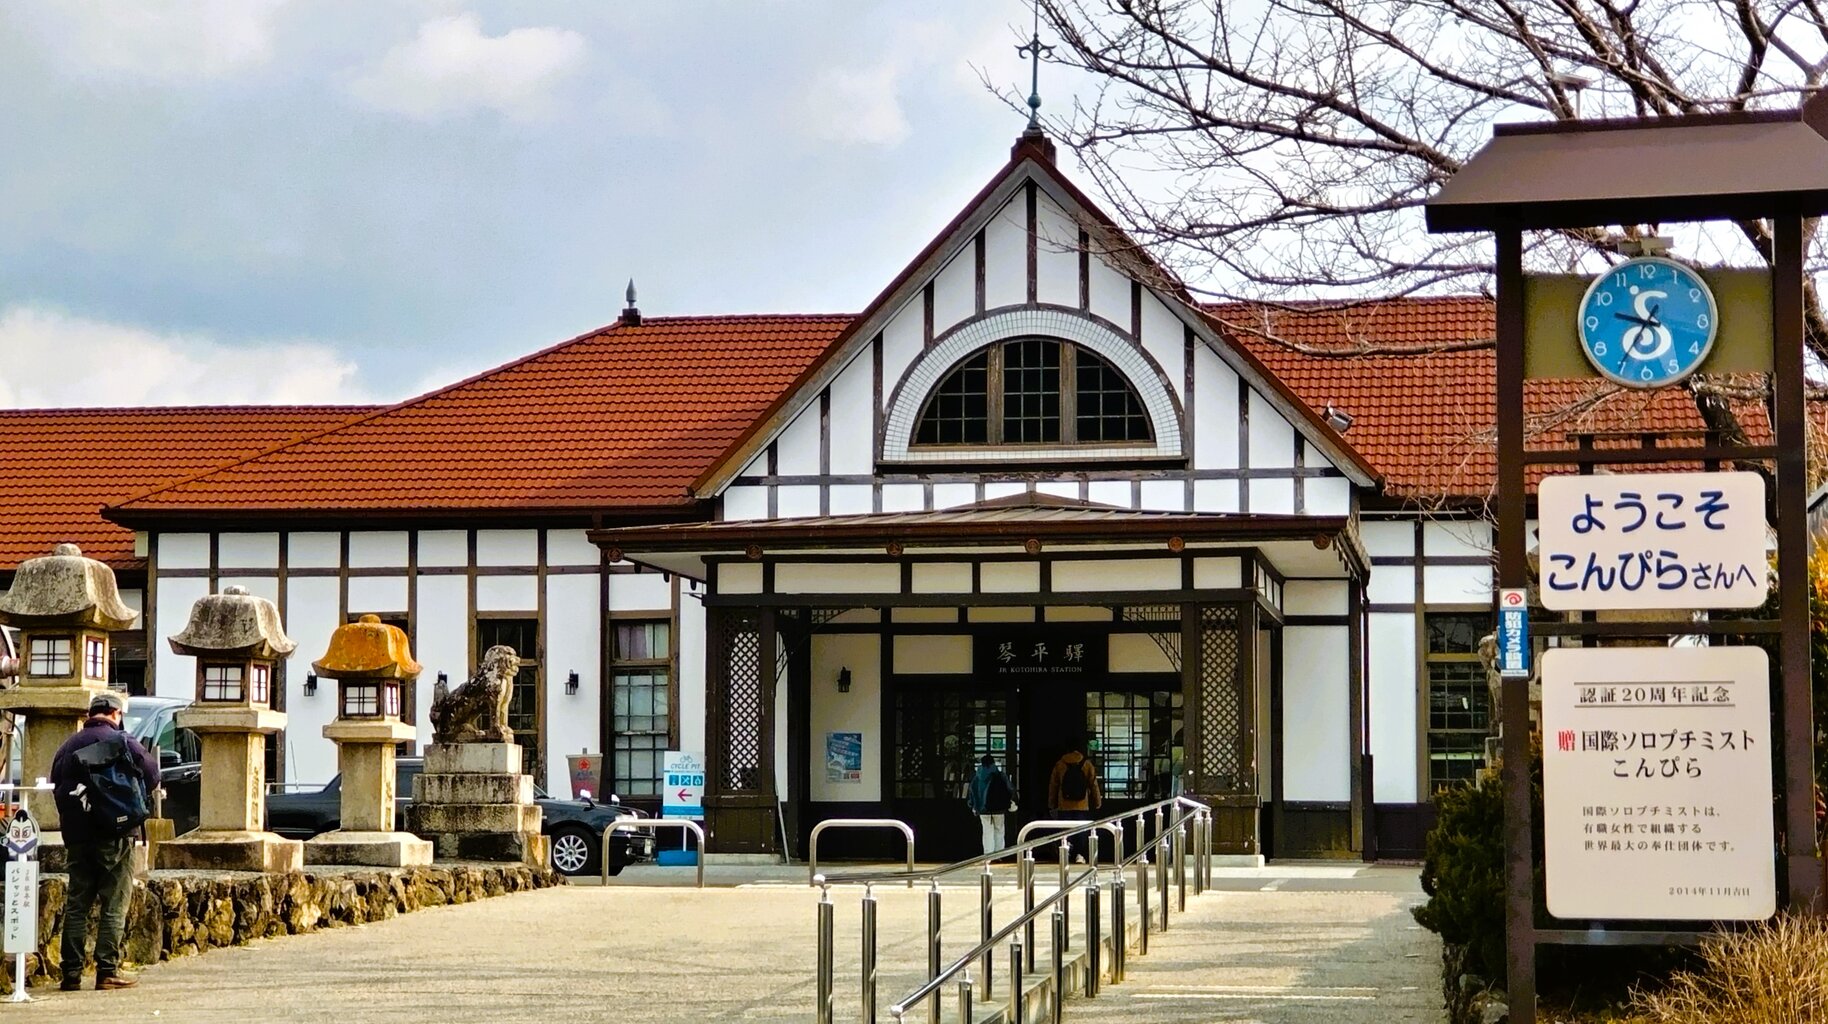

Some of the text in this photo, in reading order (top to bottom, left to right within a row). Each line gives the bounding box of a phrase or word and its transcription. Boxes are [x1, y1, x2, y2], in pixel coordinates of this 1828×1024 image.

[1615, 272, 1627, 287] 11
[1638, 264, 1656, 280] 12
[1672, 269, 1679, 285] 1
[1595, 291, 1613, 306] 10
[1689, 288, 1701, 303] 2
[1586, 316, 1599, 332] 9
[1697, 314, 1709, 329] 3
[1594, 341, 1607, 356] 8
[1689, 341, 1699, 355] 4
[1641, 365, 1653, 381] 6
[1668, 359, 1680, 374] 5
[1571, 490, 1730, 534] ようこそ
[1548, 550, 1758, 592] こんぴらさんへ
[1579, 685, 1731, 704] 認証20周年記念
[1581, 729, 1756, 752] 国際ソロプチミスト
[1612, 755, 1703, 779] こんぴら
[1584, 823, 1702, 834] 有職女性で組織する
[1584, 840, 1736, 851] 世界最大の奉仕団体です。
[1668, 886, 1751, 897] 2014年11月吉日
